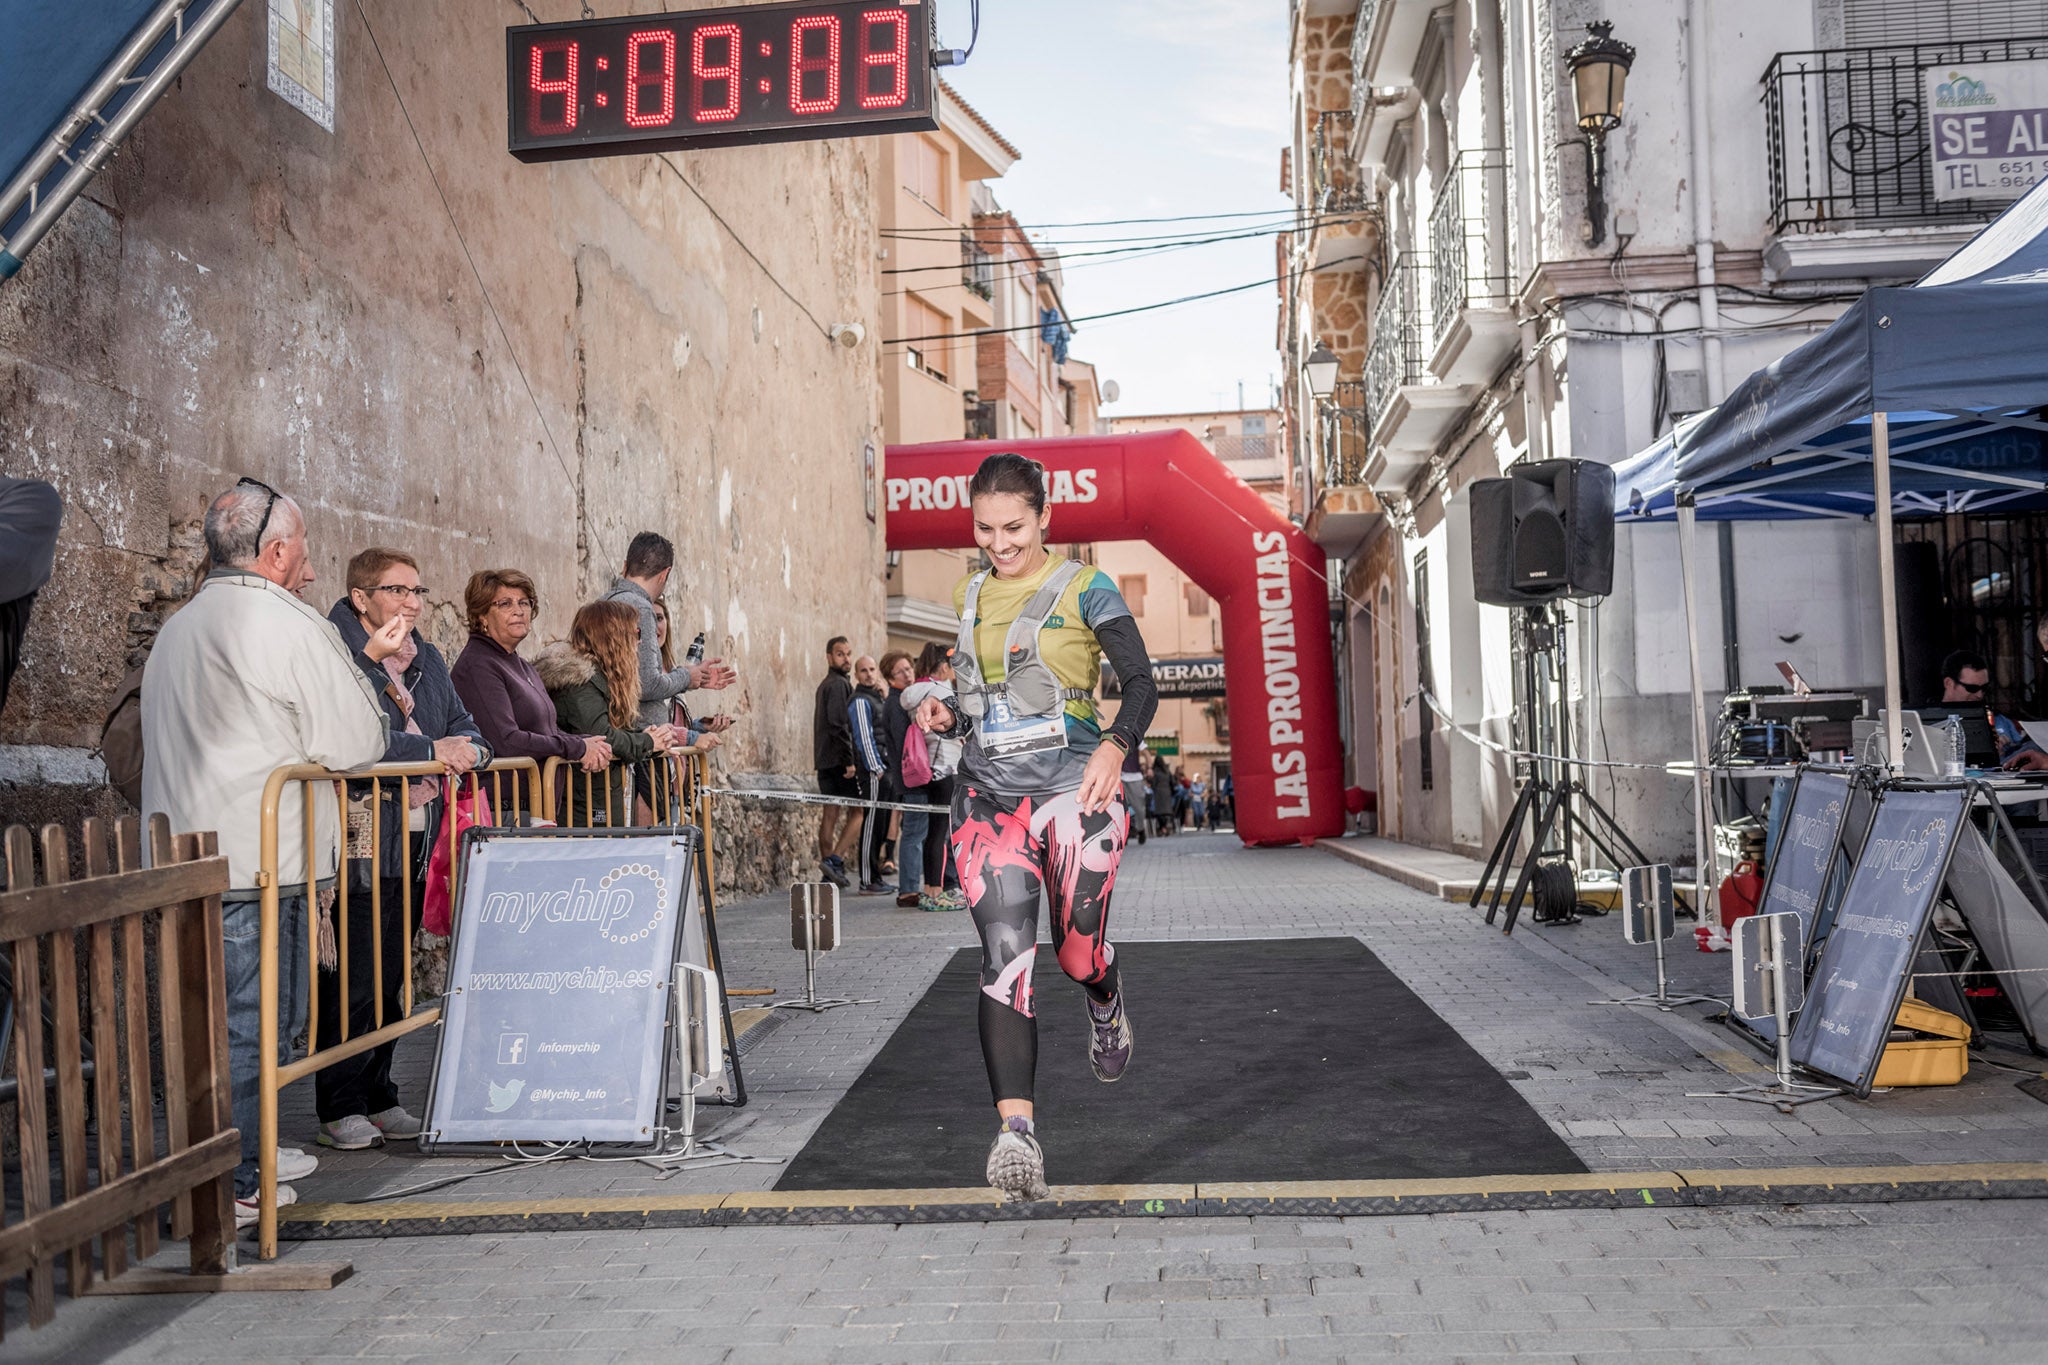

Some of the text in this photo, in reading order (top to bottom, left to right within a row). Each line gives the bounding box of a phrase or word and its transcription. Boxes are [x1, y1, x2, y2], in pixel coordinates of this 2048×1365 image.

[530, 9, 909, 128] 4:09:03
[1941, 117, 1988, 155] SE
[2000, 161, 2034, 174] 651
[1253, 530, 1310, 820] LAS PROVINCIAS
[480, 878, 634, 933] mychip
[470, 966, 652, 995] www.mychip.es
[537, 1042, 600, 1055] /infomychip
[530, 1087, 607, 1102] @Mychip_Info
